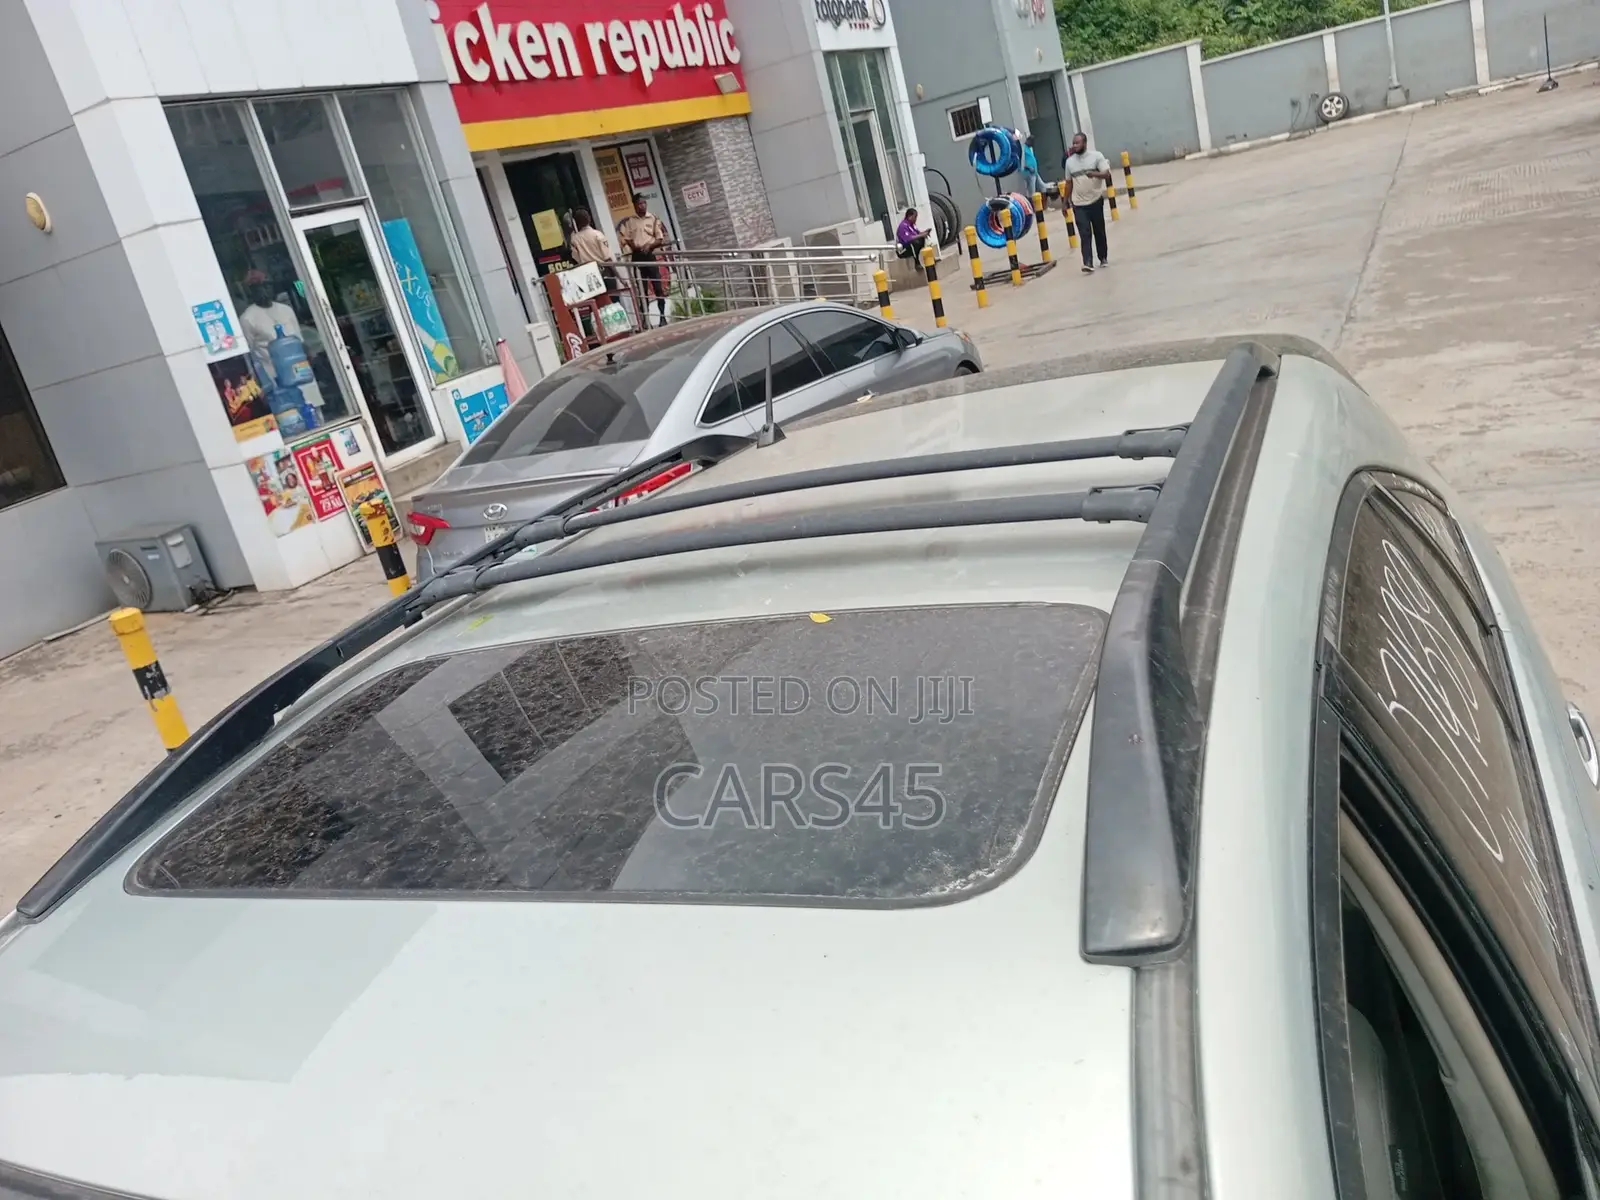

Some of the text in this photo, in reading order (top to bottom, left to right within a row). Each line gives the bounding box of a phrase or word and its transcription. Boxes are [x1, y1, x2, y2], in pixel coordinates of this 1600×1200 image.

[426, 0, 741, 87] icken republic
[687, 190, 704, 200] CCTV
